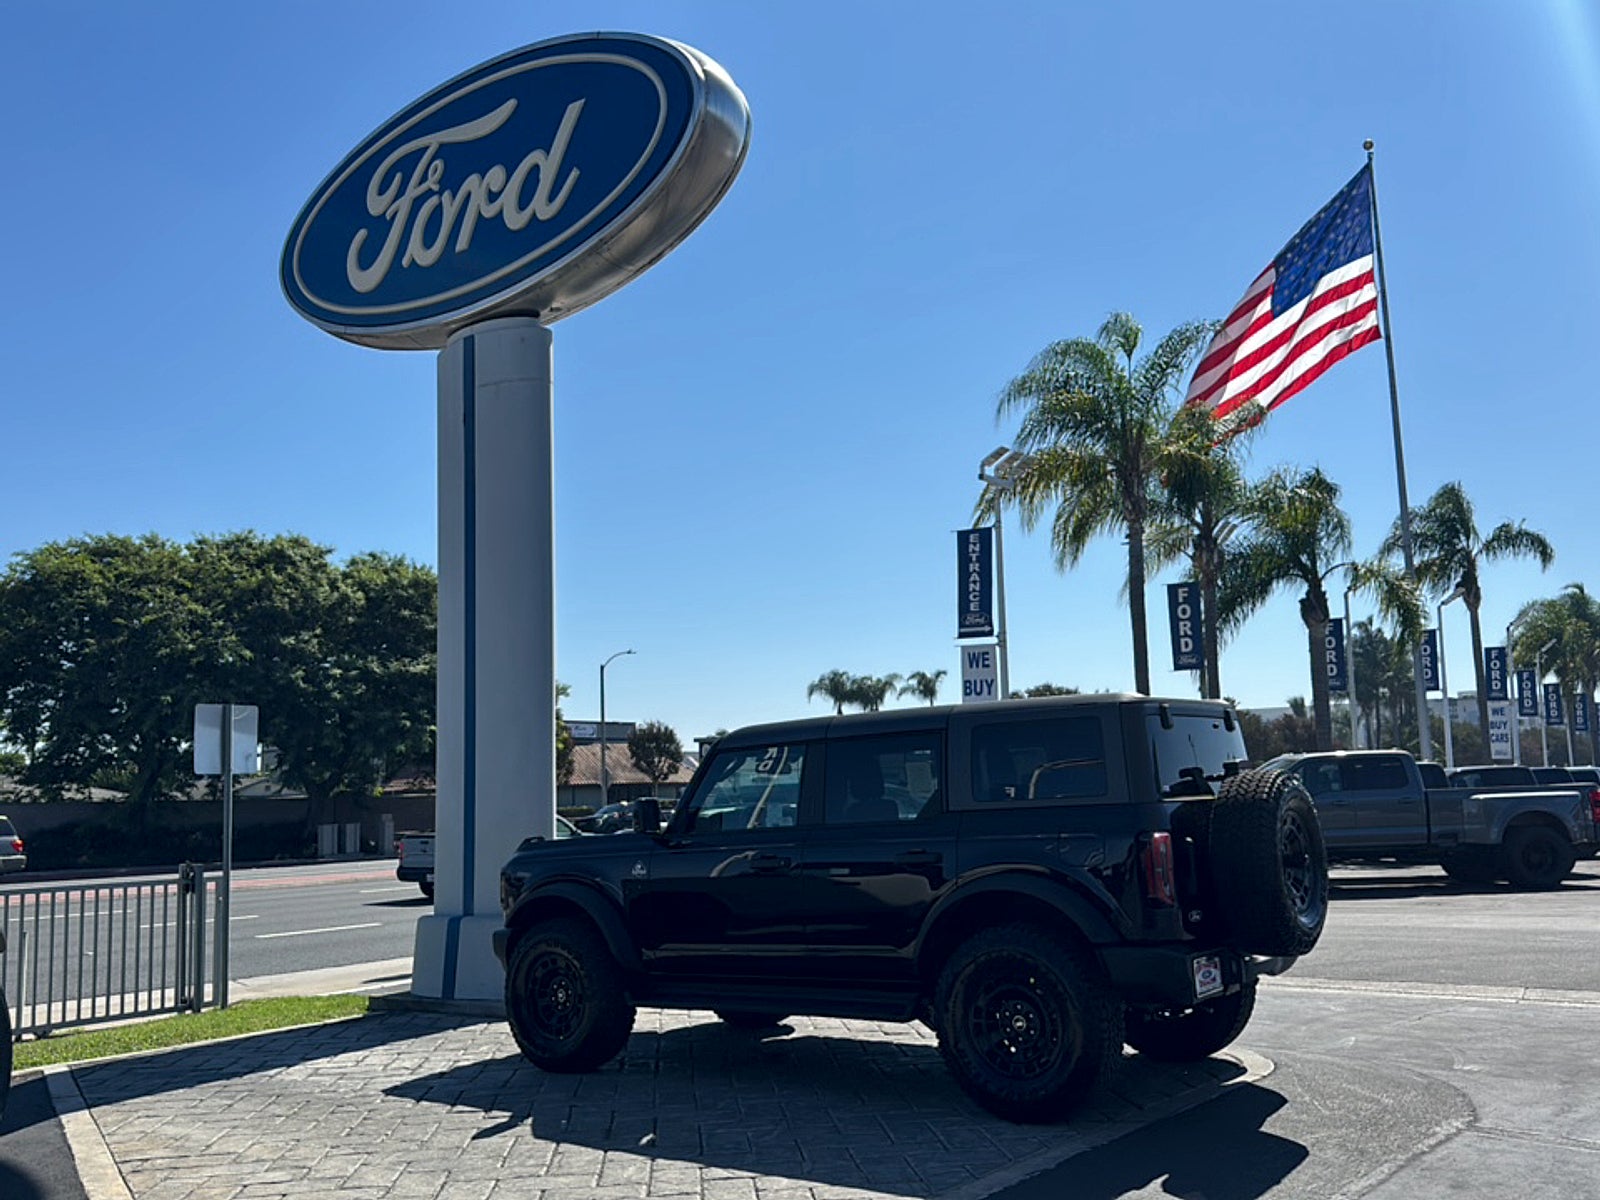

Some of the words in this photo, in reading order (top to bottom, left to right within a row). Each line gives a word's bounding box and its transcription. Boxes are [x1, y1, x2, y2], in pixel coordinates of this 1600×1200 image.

[347, 97, 586, 294] Ford
[968, 533, 981, 612] ENTRANCE
[1177, 587, 1193, 653] FORD
[967, 651, 991, 668] WE
[1325, 623, 1338, 676] FORD
[1421, 633, 1432, 679] FORD
[963, 679, 994, 696] BUY
[1490, 650, 1501, 690] FORD
[1522, 671, 1532, 708] FORD
[1548, 685, 1558, 717] FORD
[1490, 721, 1507, 730] BUY
[1491, 707, 1505, 716] WE
[1490, 733, 1509, 743] CARS
